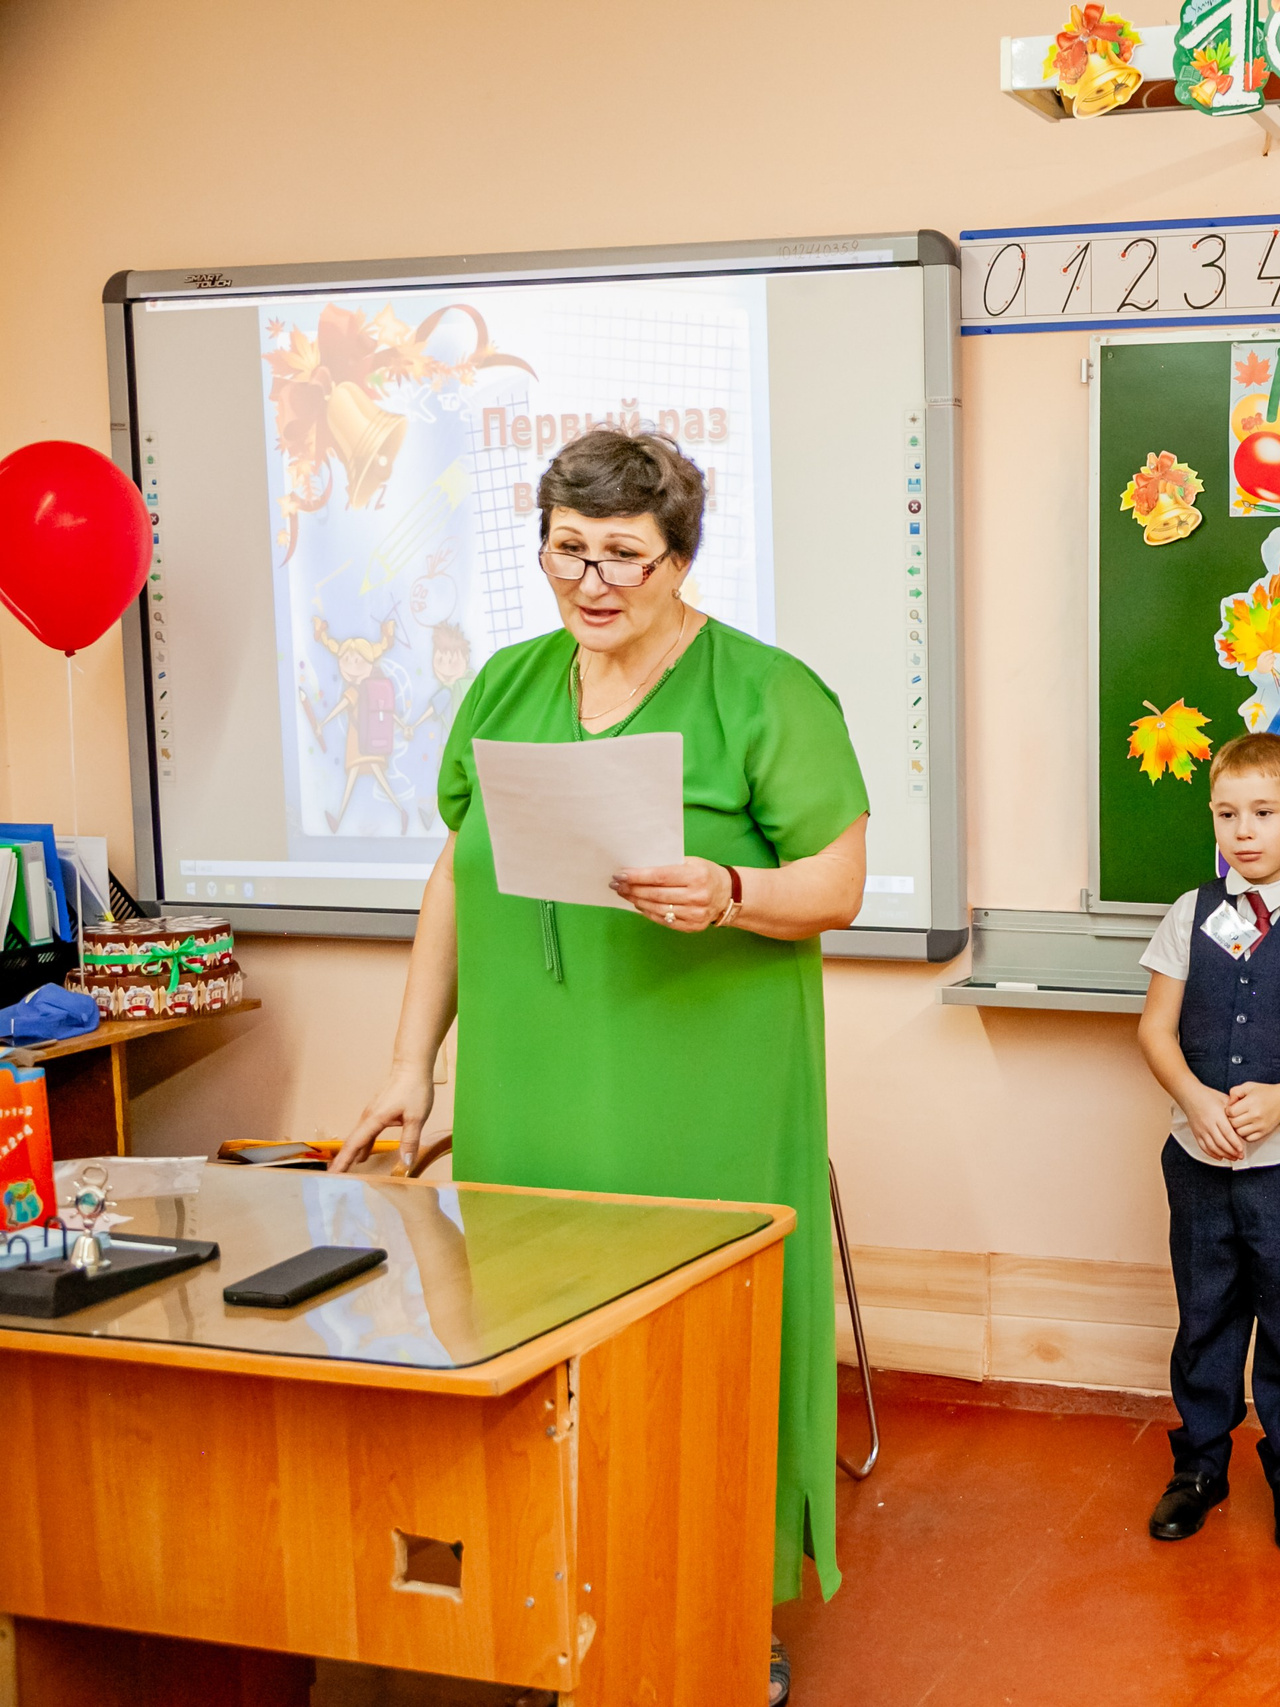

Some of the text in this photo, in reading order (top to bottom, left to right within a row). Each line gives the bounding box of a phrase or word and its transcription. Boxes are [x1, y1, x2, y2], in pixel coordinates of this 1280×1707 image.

[1178, 0, 1260, 105] 1
[184, 272, 223, 283] SMART
[196, 279, 232, 289] TOUCH
[984, 243, 1025, 316] 0
[1062, 242, 1090, 313] 1
[1117, 239, 1159, 312] 2
[1184, 234, 1226, 309] 3
